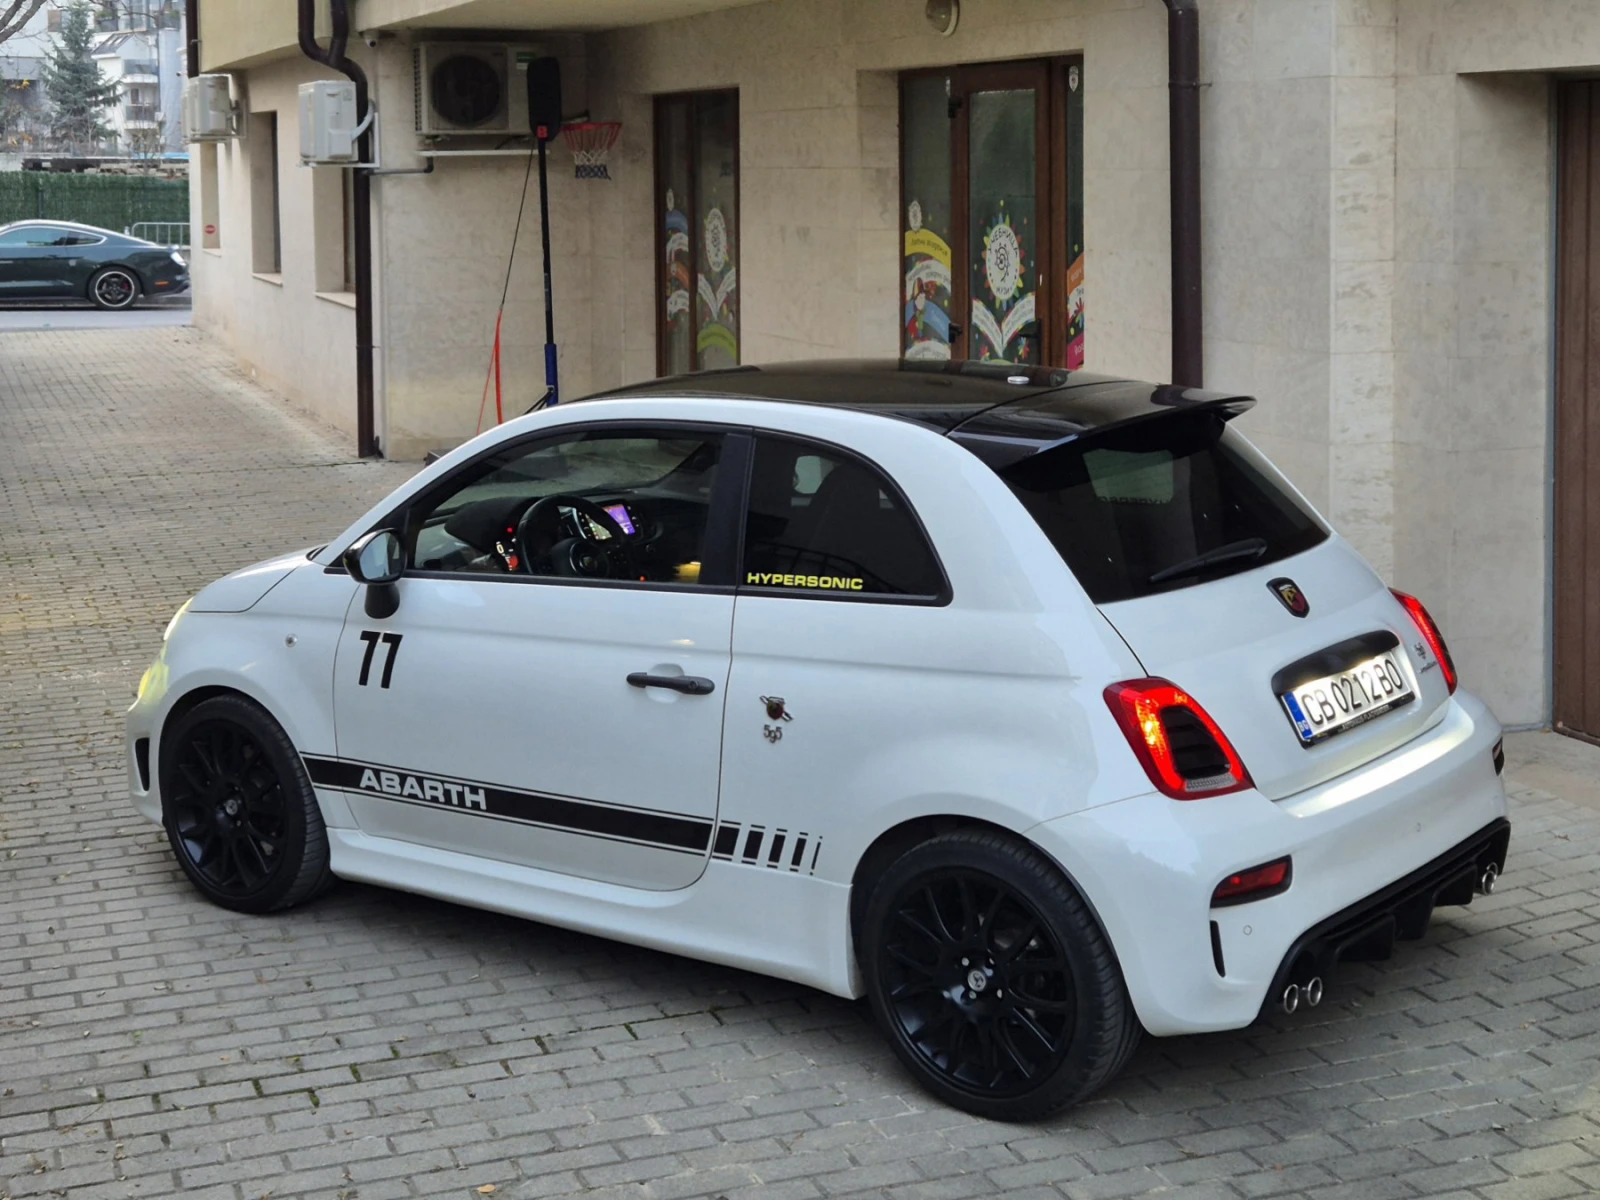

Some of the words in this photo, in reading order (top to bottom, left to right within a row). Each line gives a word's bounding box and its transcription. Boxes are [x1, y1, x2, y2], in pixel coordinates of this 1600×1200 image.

[747, 572, 863, 590] HYPERSONIC
[358, 630, 404, 689] 77
[763, 724, 783, 744] 595
[359, 768, 487, 811] ABARTH
